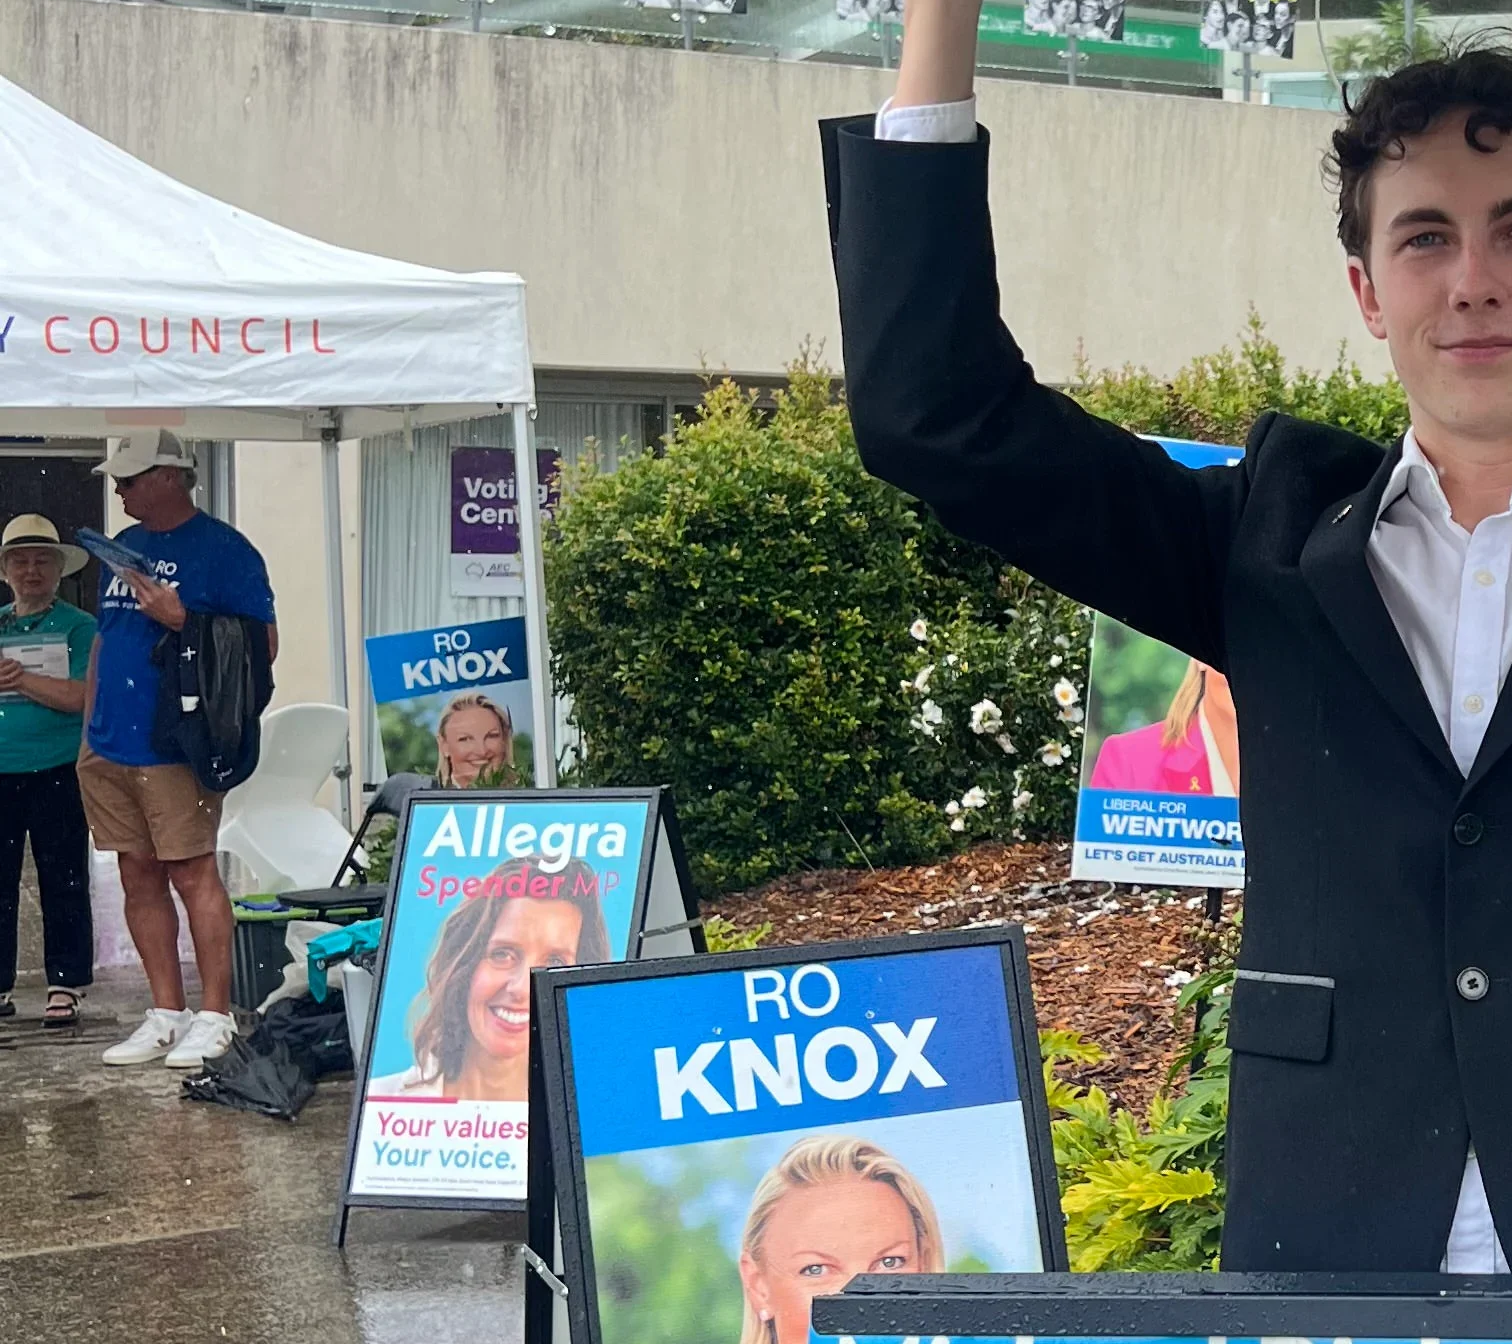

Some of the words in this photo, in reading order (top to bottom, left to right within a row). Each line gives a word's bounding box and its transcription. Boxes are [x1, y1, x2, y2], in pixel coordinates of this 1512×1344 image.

[44, 316, 337, 354] COUNCIL
[463, 477, 549, 504] Votig
[156, 559, 178, 576] RO
[433, 629, 471, 653] RO
[402, 647, 512, 690] KNOX
[1103, 798, 1156, 813] LIBERAL
[1159, 802, 1186, 815] FOR
[422, 805, 627, 873] Allegra
[1085, 848, 1123, 861] LET'S
[1127, 851, 1155, 863] GET
[1159, 853, 1236, 868] AUSTRALIA
[417, 864, 565, 905] Spender
[572, 872, 620, 897] MP
[743, 965, 841, 1023] RO
[654, 1017, 947, 1121] KNOX
[377, 1112, 436, 1137] Your
[444, 1113, 528, 1140] values
[373, 1140, 431, 1166] Your
[440, 1143, 516, 1170] voice.
